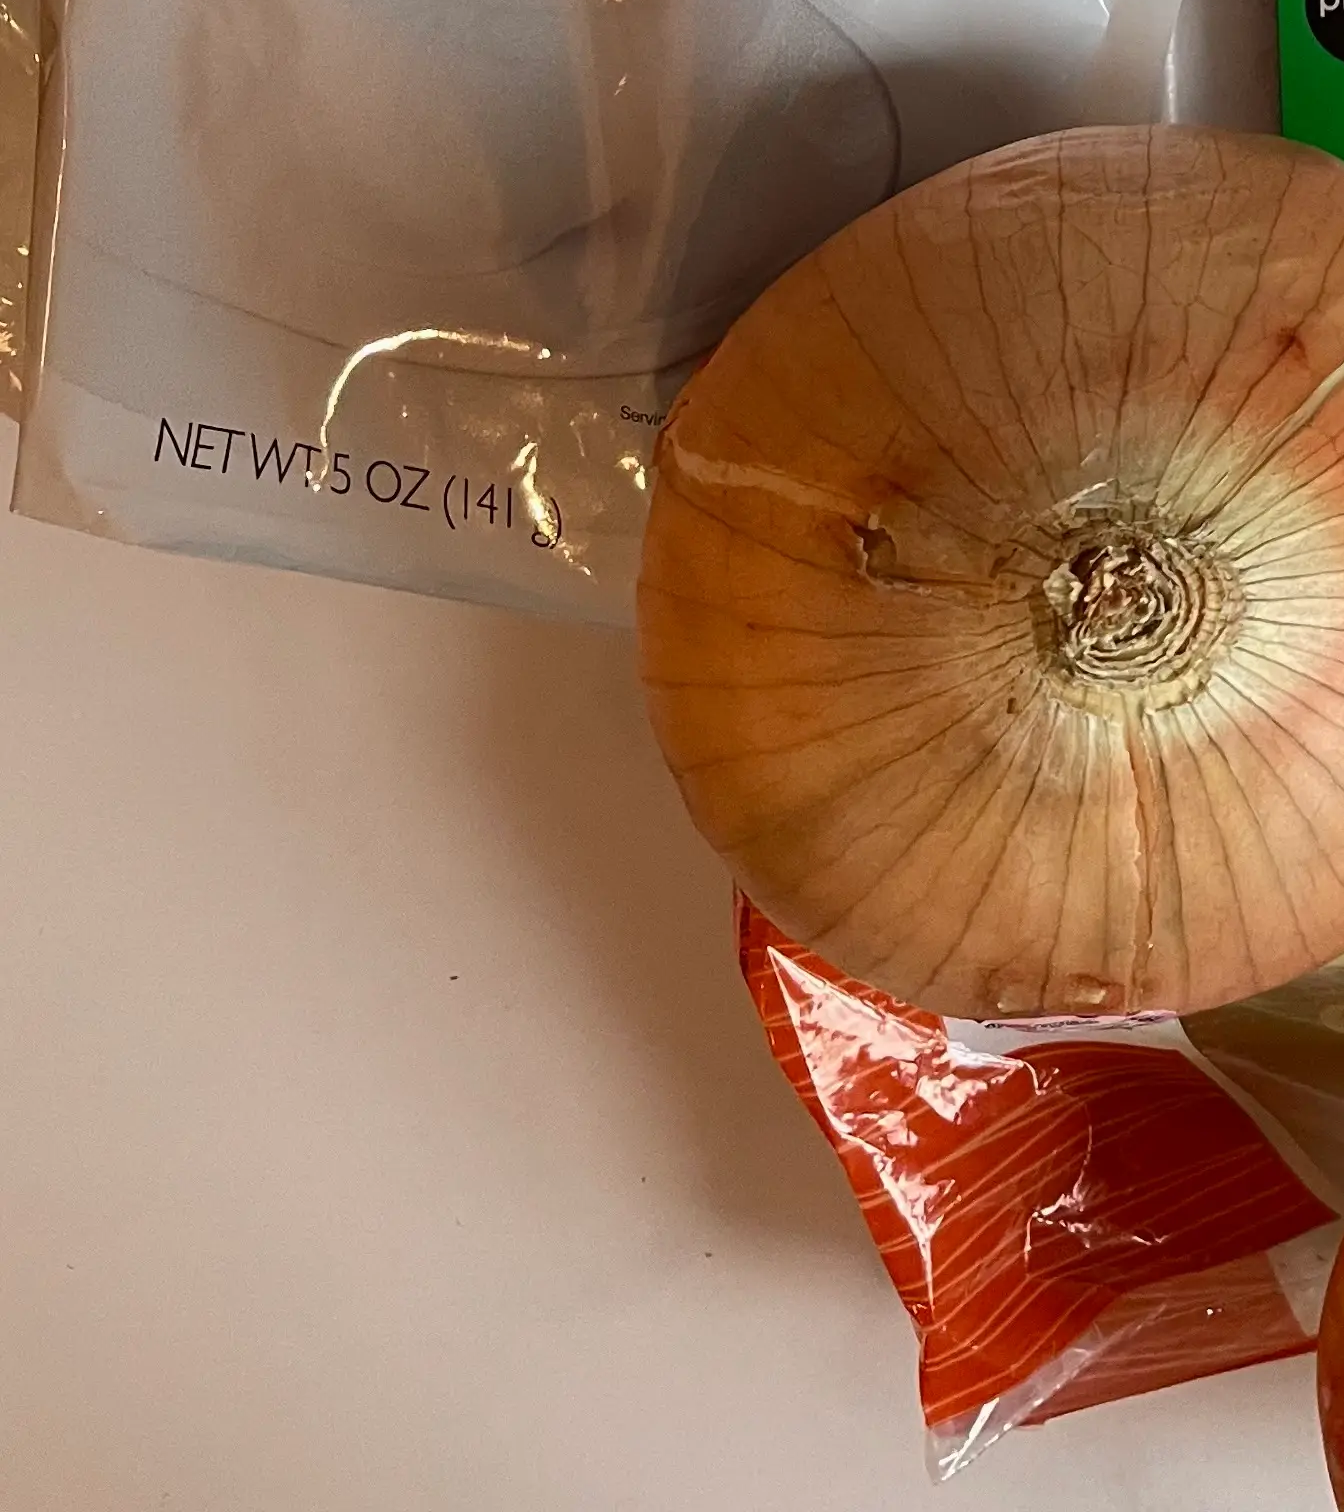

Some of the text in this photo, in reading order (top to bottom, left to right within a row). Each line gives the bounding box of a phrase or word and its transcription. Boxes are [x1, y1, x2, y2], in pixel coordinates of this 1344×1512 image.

[154, 418, 431, 511] NET WT OZ
